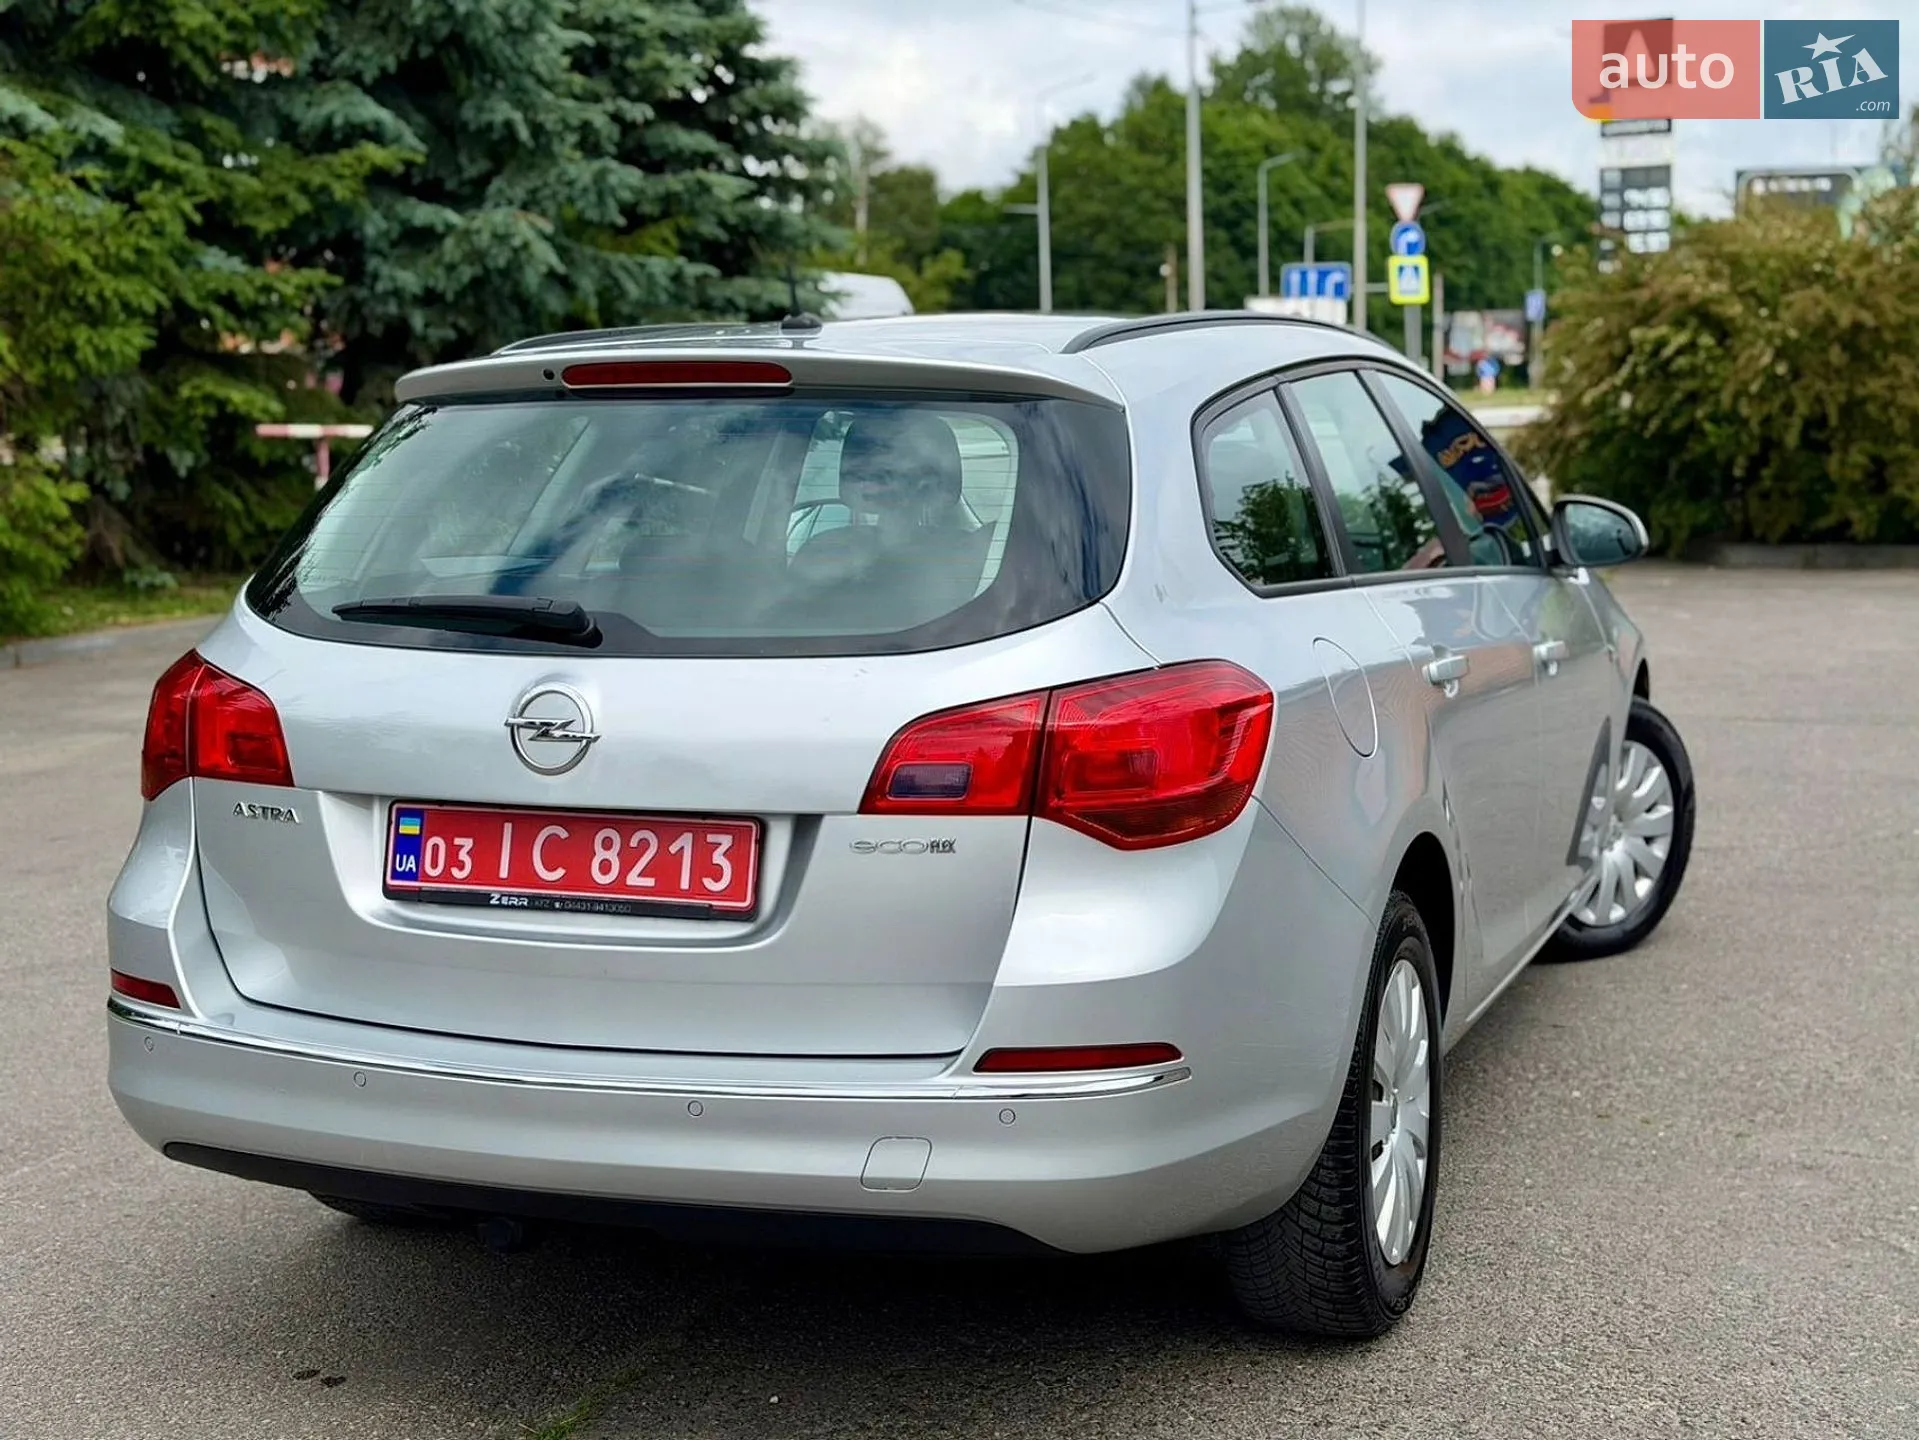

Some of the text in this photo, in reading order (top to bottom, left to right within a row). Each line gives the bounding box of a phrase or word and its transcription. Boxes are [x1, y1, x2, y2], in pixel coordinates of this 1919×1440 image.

[232, 801, 300, 824] ASTRA
[396, 854, 416, 872] UA
[424, 836, 473, 880] 03
[590, 828, 732, 892] 8213
